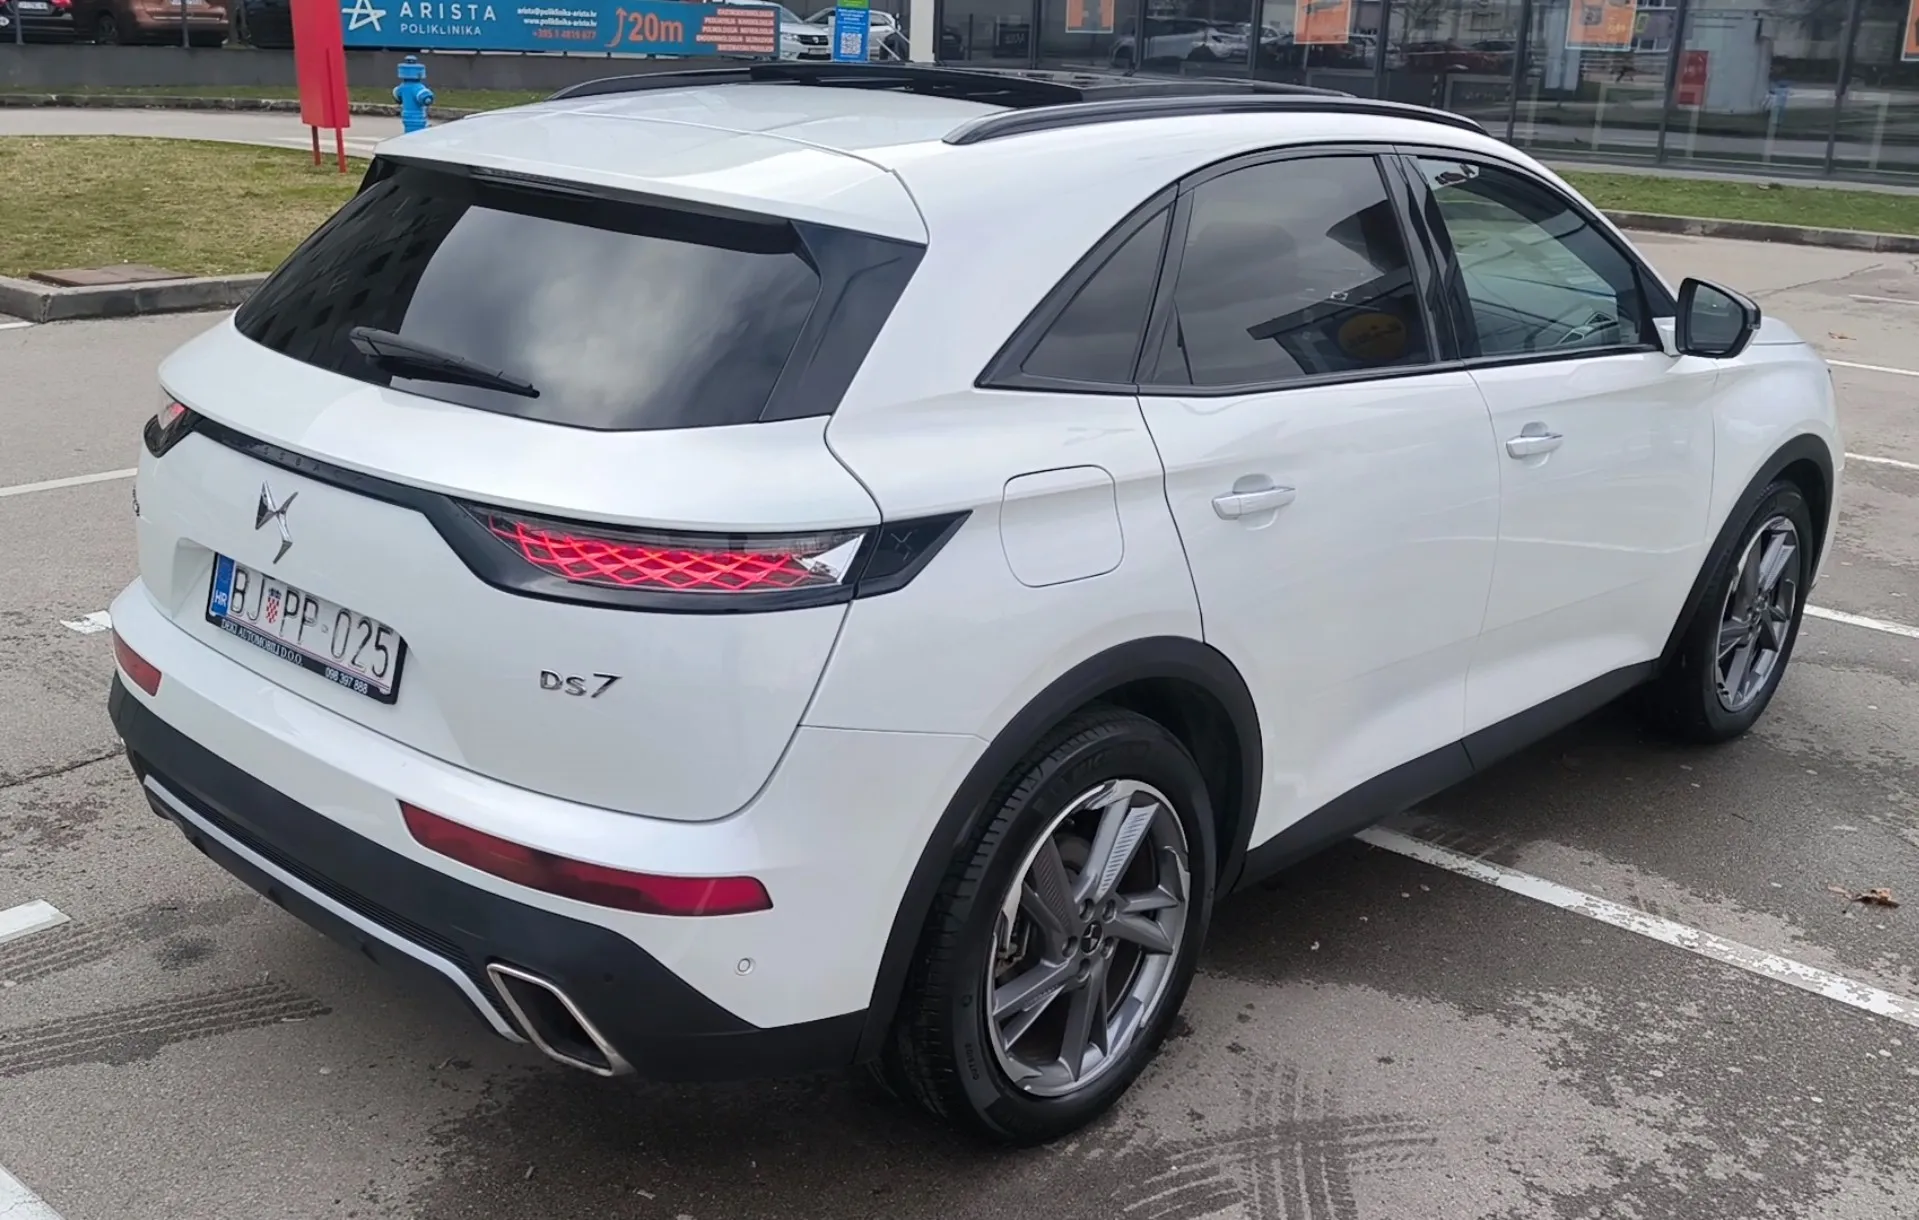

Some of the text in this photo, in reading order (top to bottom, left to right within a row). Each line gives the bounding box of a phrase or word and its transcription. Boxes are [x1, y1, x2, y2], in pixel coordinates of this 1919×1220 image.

[400, 2, 496, 21] ARISTA
[400, 23, 482, 36] POLIKLINIKA
[628, 13, 683, 43] 20m
[214, 590, 228, 606] HR
[230, 567, 265, 622] BJ
